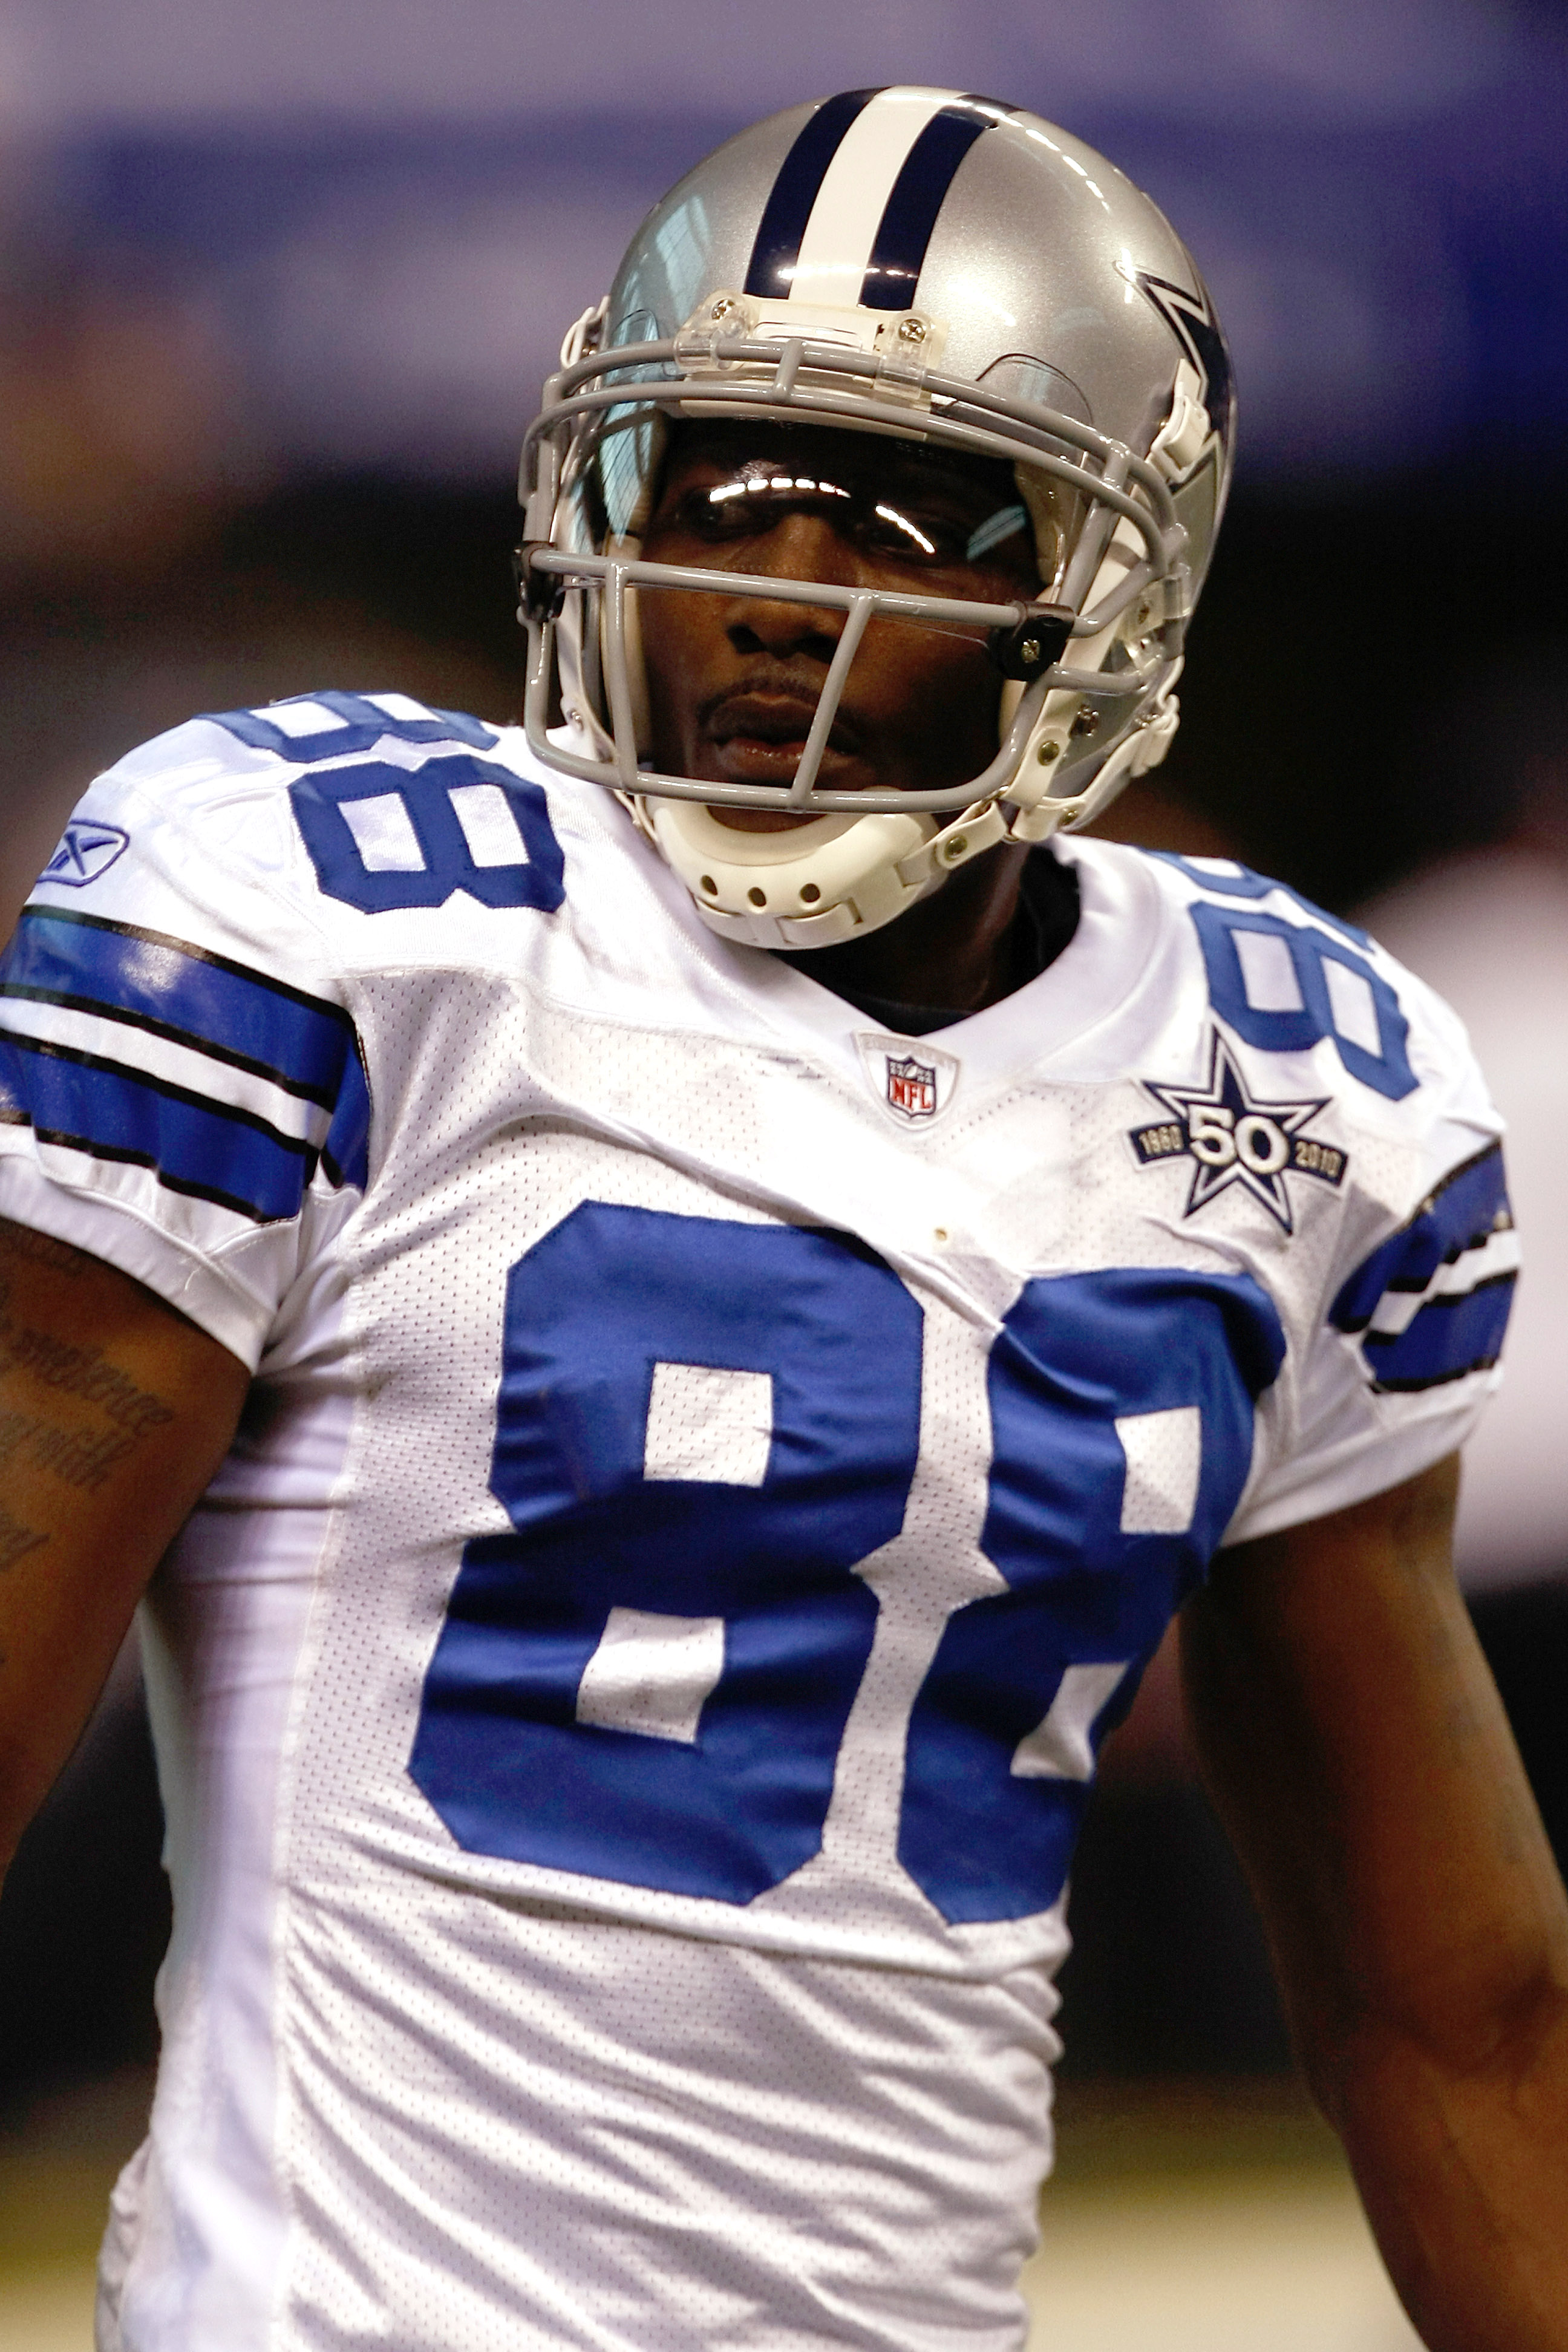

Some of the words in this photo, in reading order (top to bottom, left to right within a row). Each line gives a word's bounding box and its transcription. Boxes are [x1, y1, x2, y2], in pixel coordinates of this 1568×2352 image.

[890, 1076, 932, 1111] NFL
[1189, 1104, 1290, 1174] 50
[1295, 1141, 1342, 1178] 2010
[407, 1199, 1287, 1927] 88
